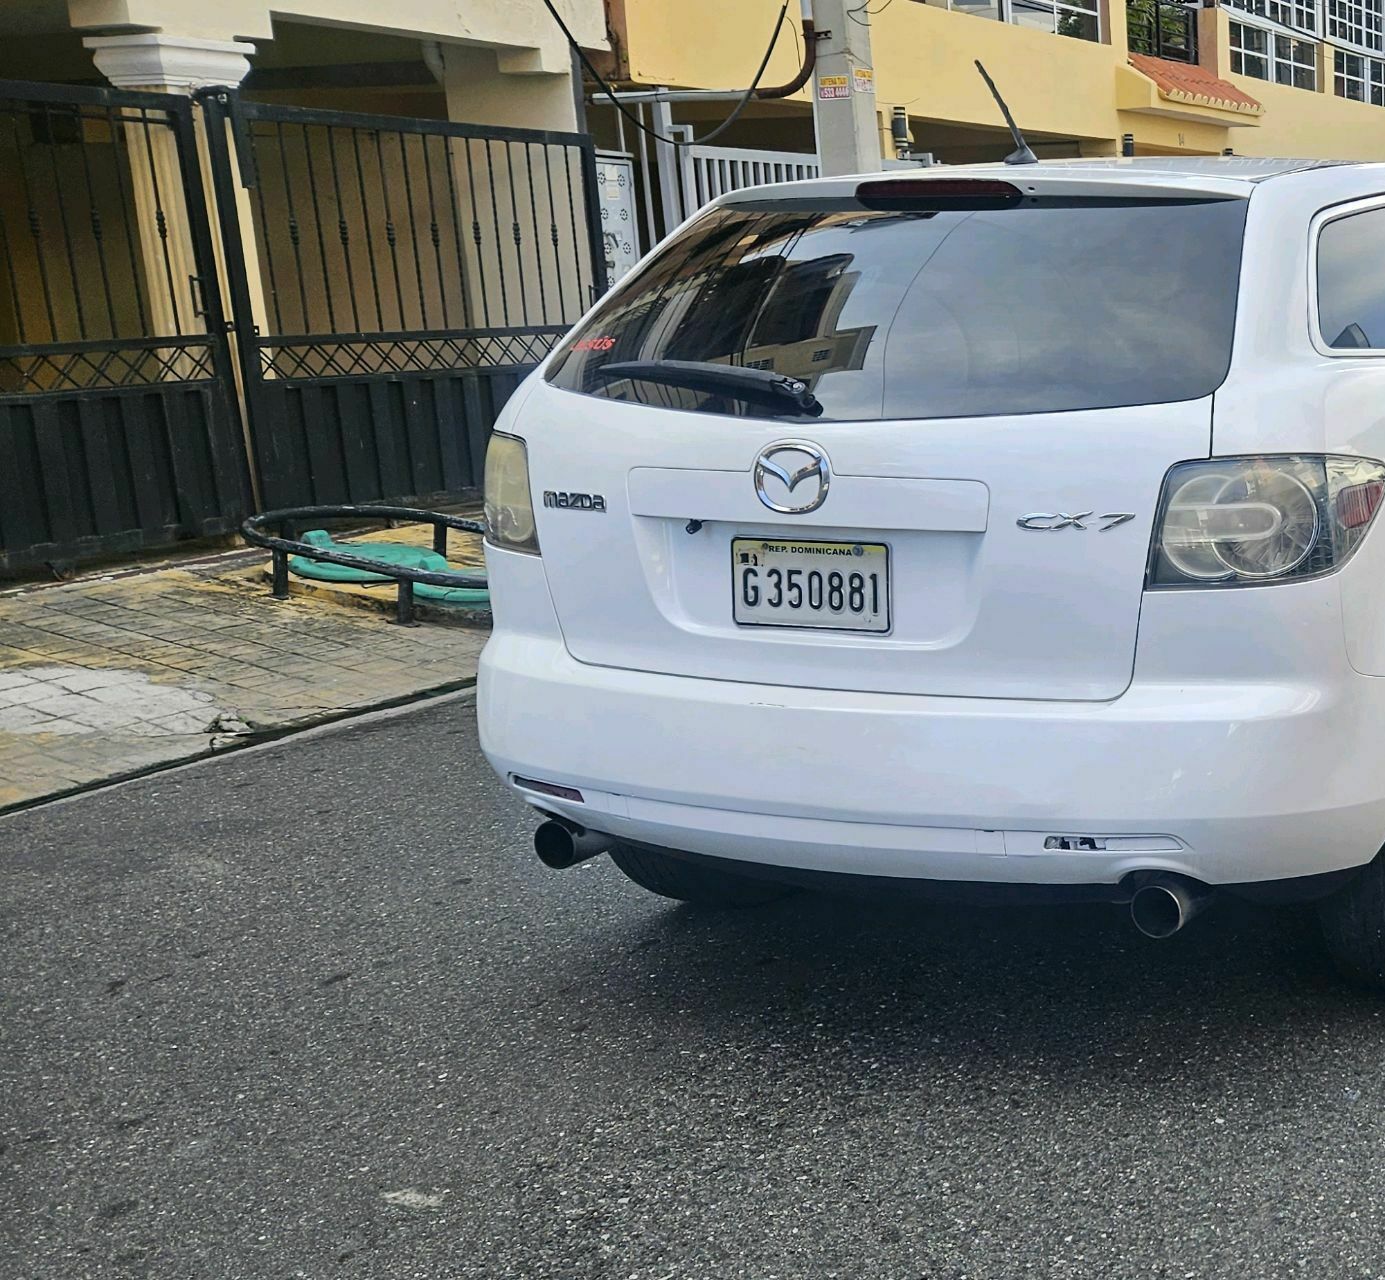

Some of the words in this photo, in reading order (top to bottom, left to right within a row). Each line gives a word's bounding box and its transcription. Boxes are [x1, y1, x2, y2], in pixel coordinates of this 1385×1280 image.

[768, 545, 788, 553] REP.
[791, 546, 853, 556] DOMINICANA
[743, 567, 878, 614] G350881
